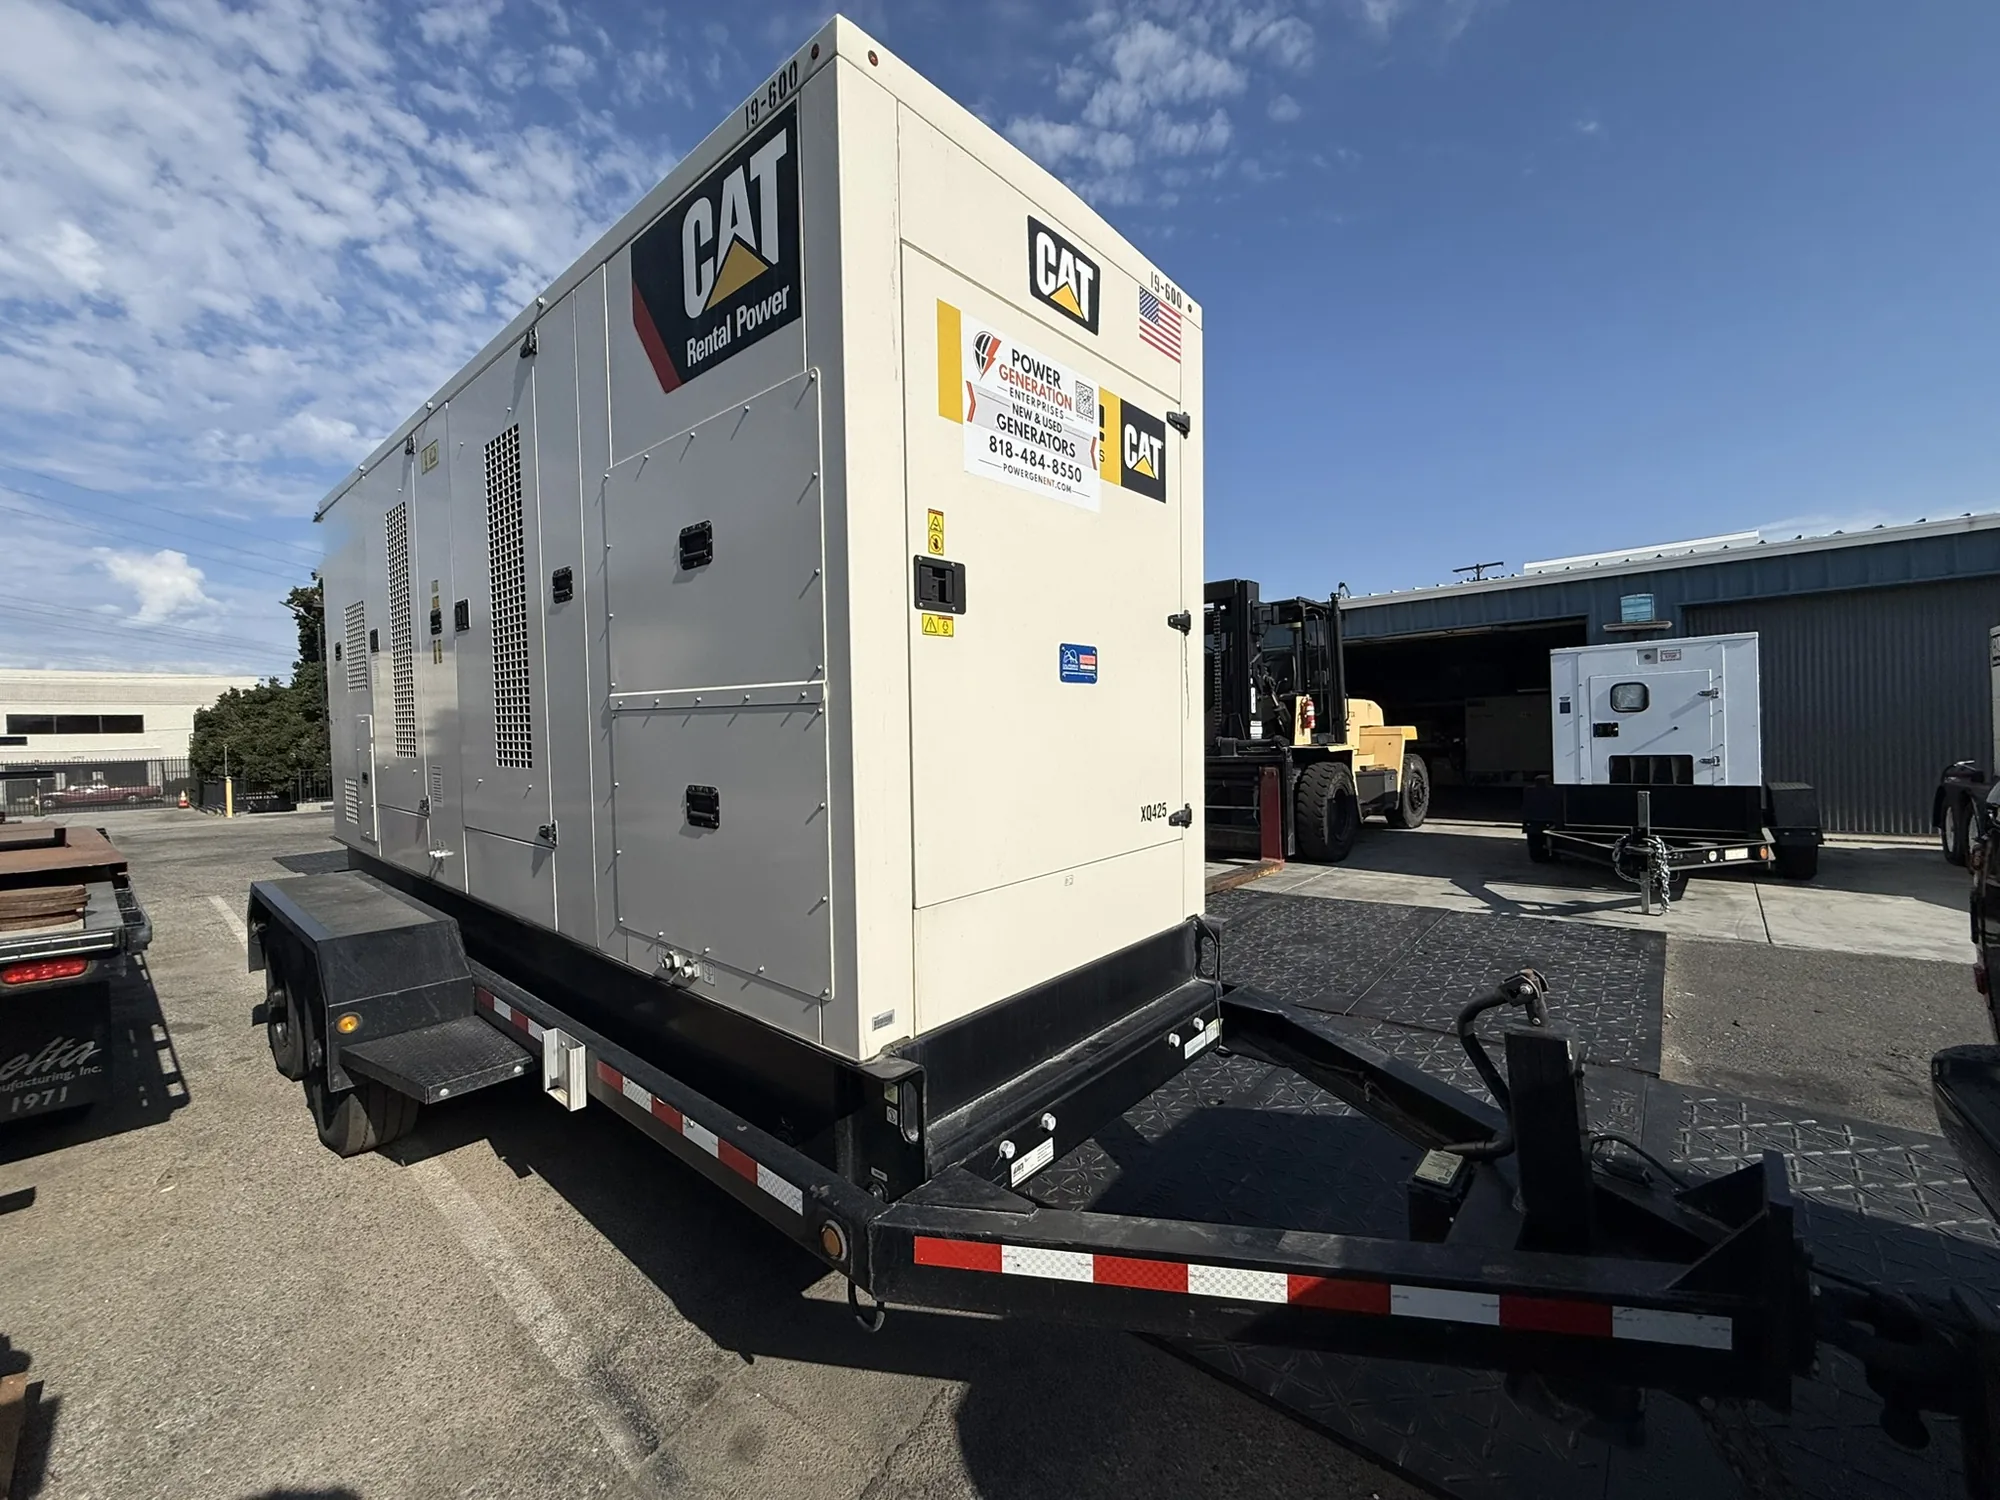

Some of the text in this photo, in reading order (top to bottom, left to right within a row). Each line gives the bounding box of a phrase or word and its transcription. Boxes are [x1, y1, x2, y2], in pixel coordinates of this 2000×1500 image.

[744, 60, 798, 130] 19-600
[682, 128, 787, 319] CAT
[1036, 231, 1093, 322] CAT
[1151, 271, 1182, 309] 19-600
[687, 285, 790, 367] Rental Power
[999, 364, 1072, 411] GENERATION
[1012, 348, 1062, 390] POWER
[1009, 387, 1064, 420] ENTERPRISES
[1012, 403, 1032, 420] NEW
[1034, 415, 1041, 425] &
[1043, 418, 1062, 433] USED
[997, 413, 1076, 458] GENERATORS
[1124, 423, 1162, 480] CAT
[989, 435, 1082, 483] 818-484-8550
[1003, 463, 1072, 493] POWERGENENT.COM
[1140, 802, 1167, 822] XQ425
[80, 1065, 102, 1076] Inc.
[11, 1086, 67, 1113] 1971
